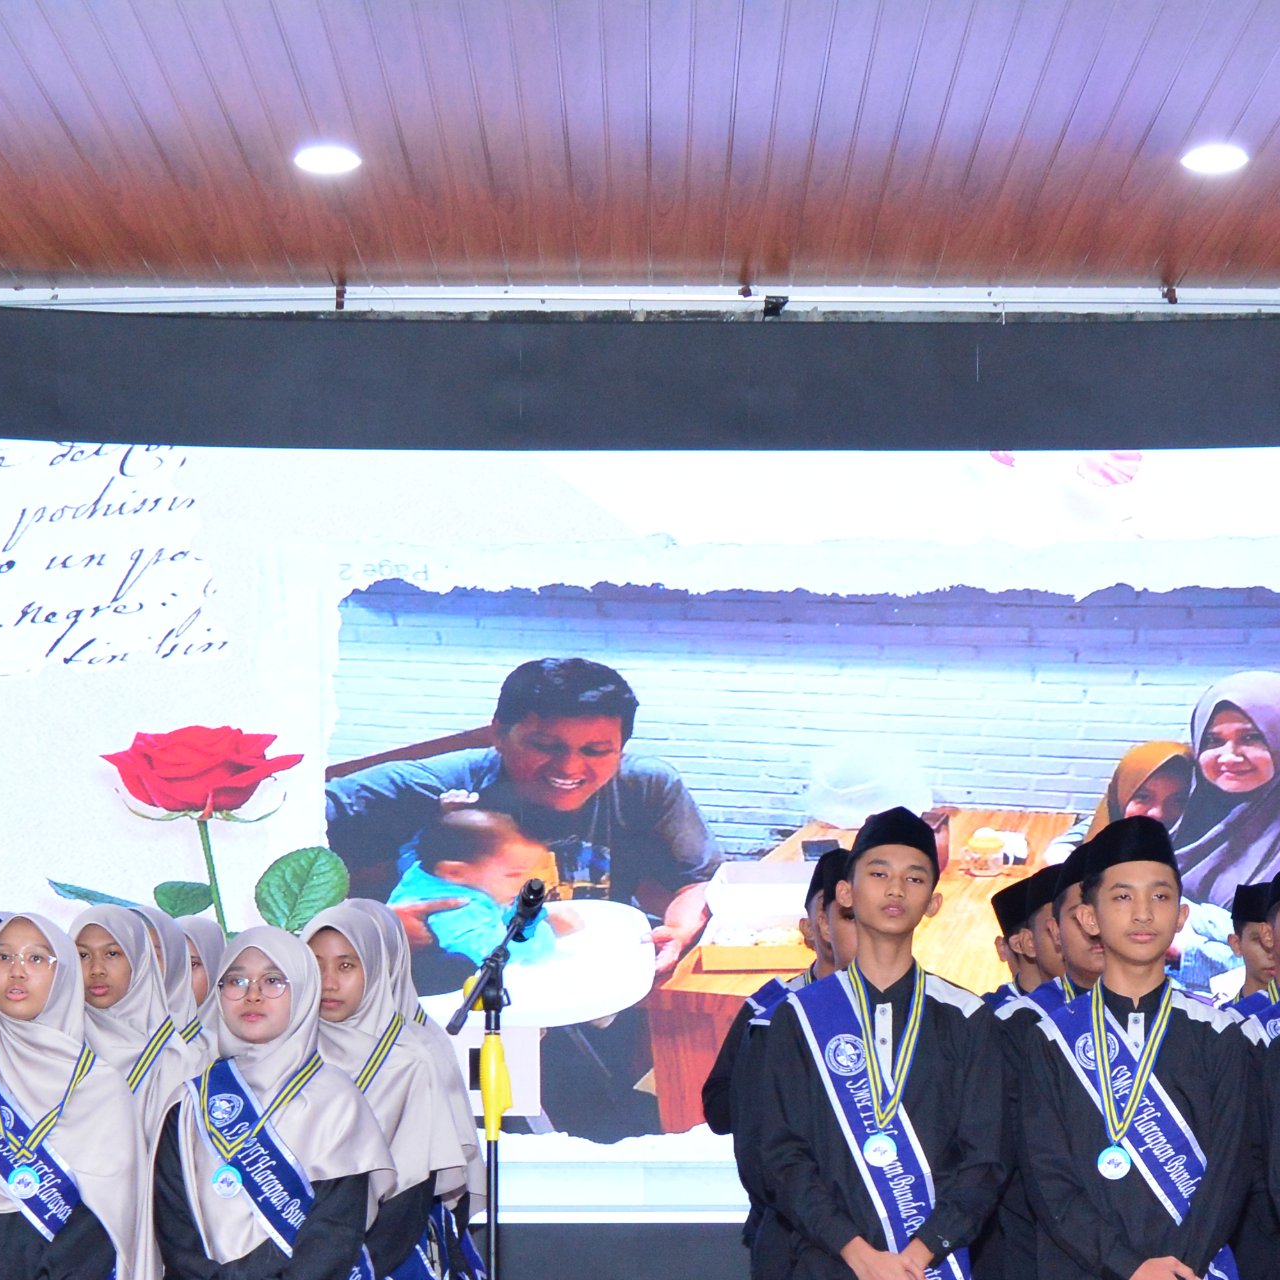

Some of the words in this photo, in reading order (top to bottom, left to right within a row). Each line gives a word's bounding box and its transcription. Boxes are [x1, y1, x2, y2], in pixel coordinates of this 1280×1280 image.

[236, 1144, 270, 1172] IT
[1132, 1106, 1175, 1164] Harapan
[249, 1158, 290, 1212] Harapan
